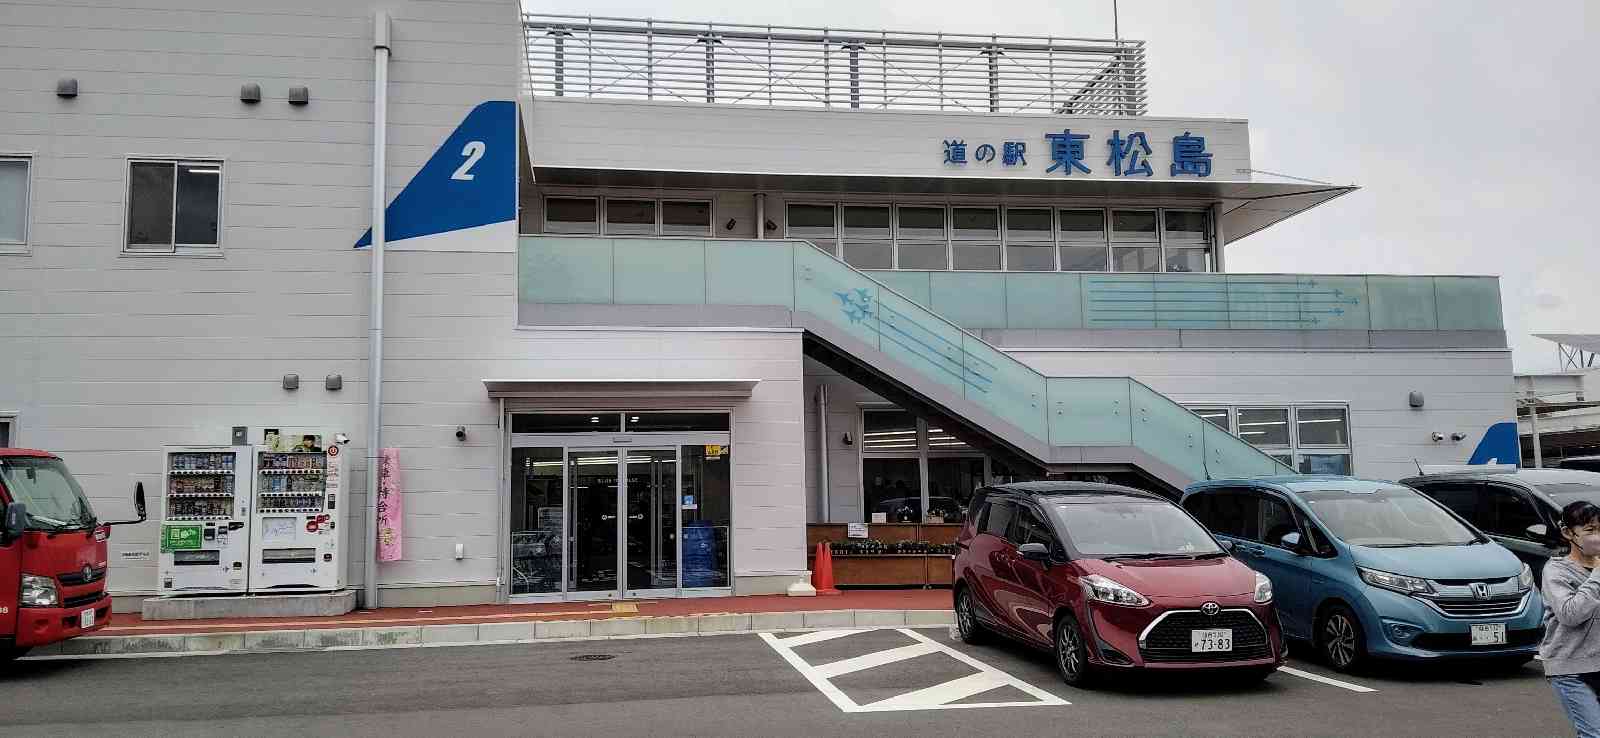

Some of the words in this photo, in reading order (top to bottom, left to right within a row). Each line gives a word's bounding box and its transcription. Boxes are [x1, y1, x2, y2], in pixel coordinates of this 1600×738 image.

[450, 141, 486, 180] 2
[943, 140, 1026, 166] 道の駅
[1045, 128, 1213, 177] 東松島
[1201, 638, 1230, 651] 73-83
